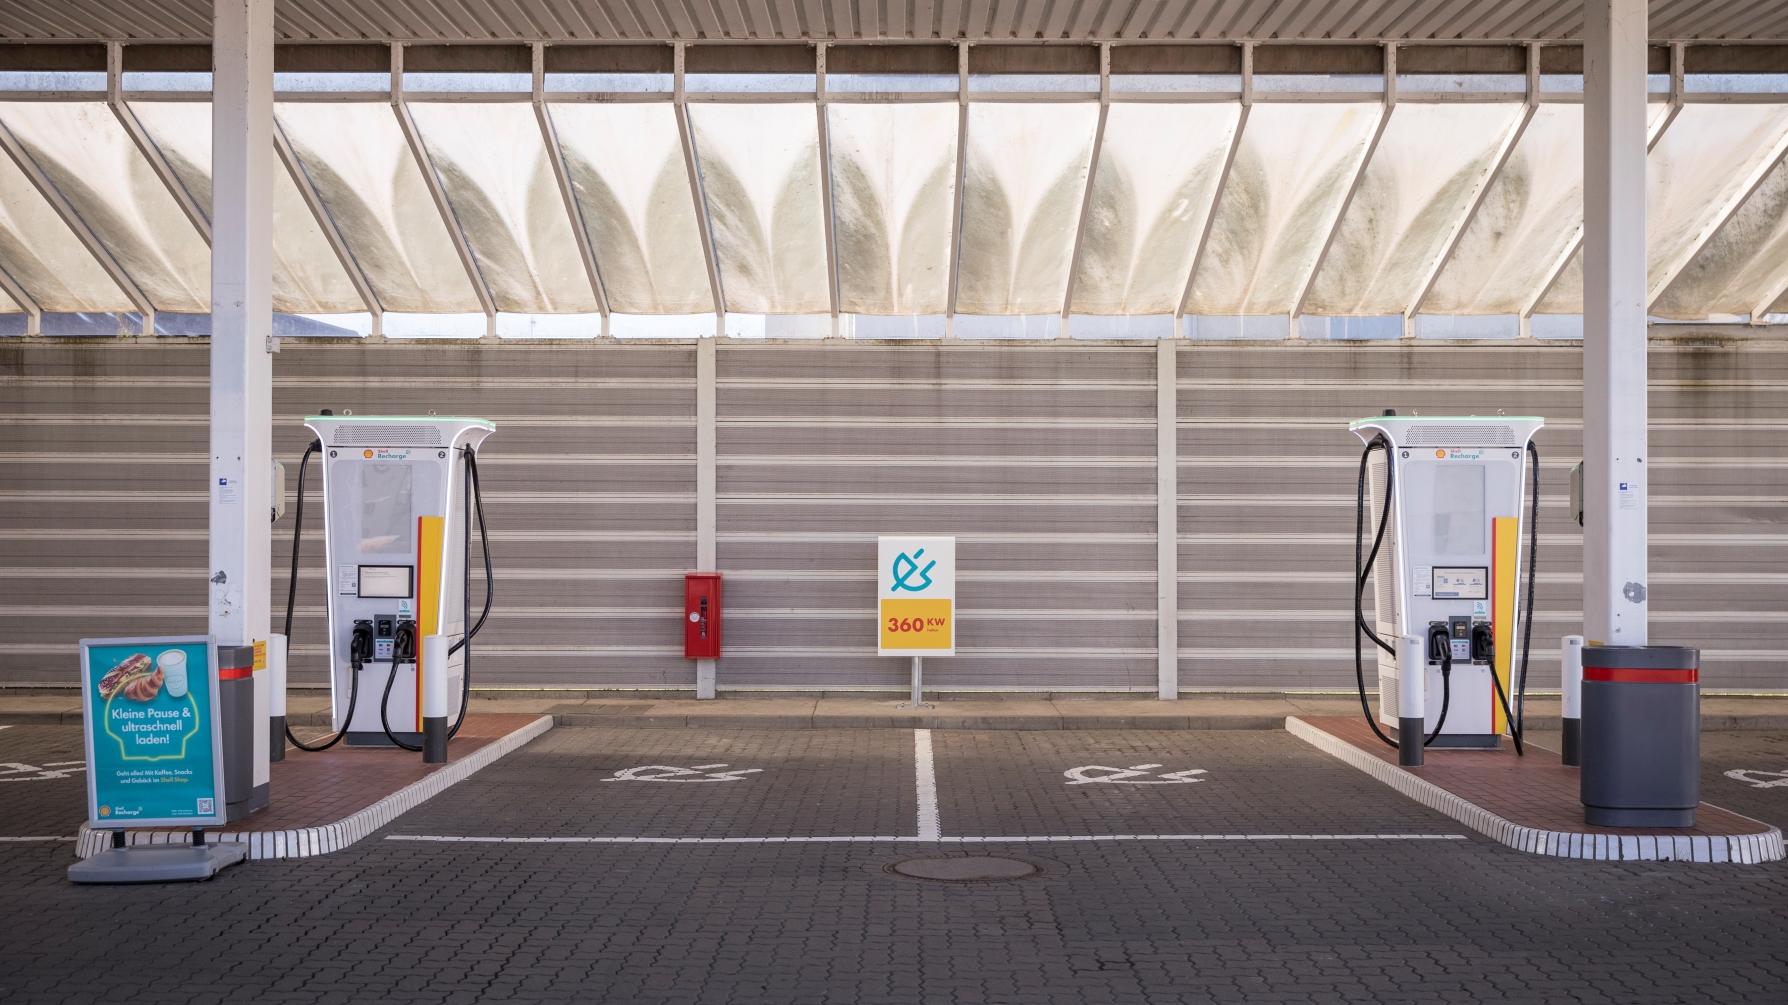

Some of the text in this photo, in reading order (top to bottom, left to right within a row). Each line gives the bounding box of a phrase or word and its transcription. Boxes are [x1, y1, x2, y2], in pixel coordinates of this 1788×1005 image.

[888, 617, 945, 632] 360 KW
[112, 707, 191, 719] Kleine Pause &
[122, 720, 182, 732] ultraschnell
[135, 734, 169, 744] laden!
